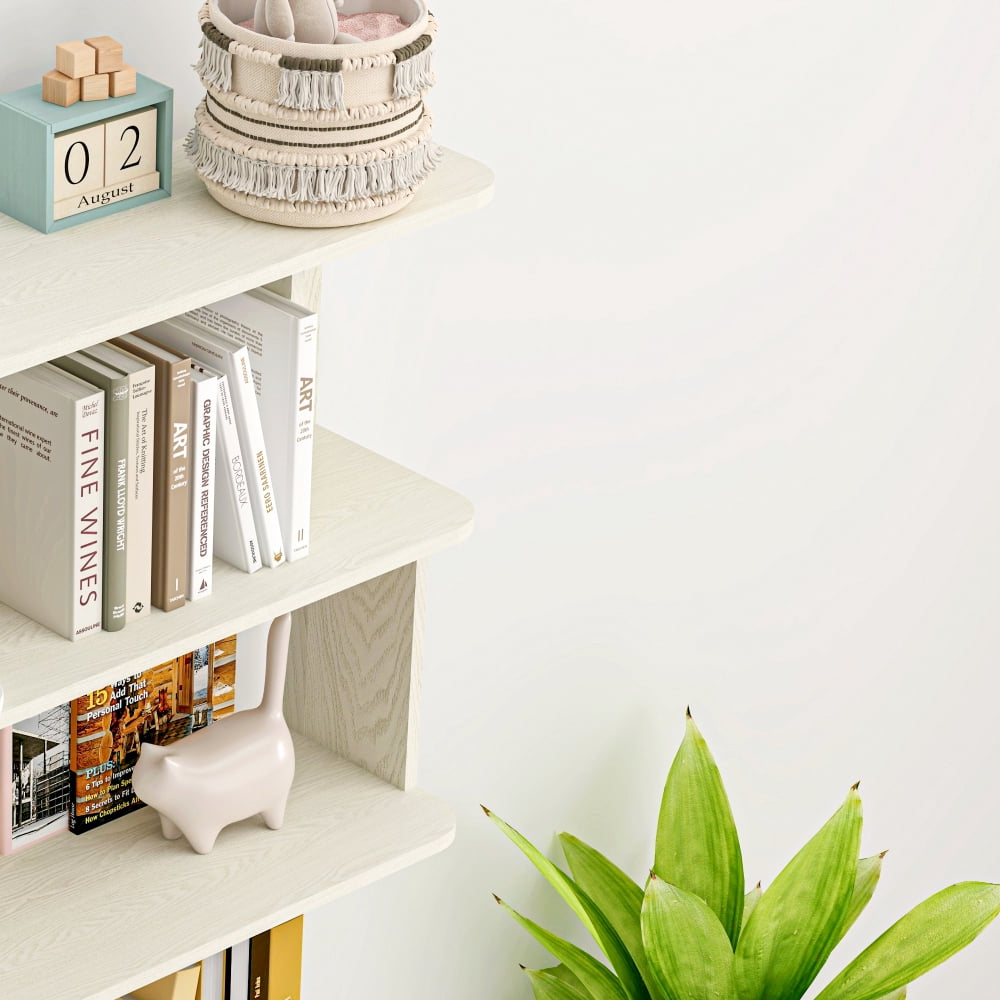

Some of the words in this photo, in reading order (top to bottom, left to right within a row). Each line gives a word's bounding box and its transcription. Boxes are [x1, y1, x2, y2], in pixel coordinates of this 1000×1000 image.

[77, 181, 134, 208] August
[298, 377, 314, 412] ART
[202, 399, 212, 446] GRAPHIC
[36, 434, 52, 446] expert
[173, 422, 188, 458] ART
[81, 429, 98, 498] FINE
[117, 458, 126, 488] FRANK
[201, 449, 210, 488] DESIGN
[256, 450, 270, 492] SAARINEN
[232, 456, 248, 508] BORDEAUX
[116, 488, 126, 516] LLOYD
[266, 493, 274, 513] EERO
[116, 518, 125, 551] WRIGHT
[200, 490, 209, 558] REFERENCED
[80, 507, 98, 606] WINES
[86, 690, 108, 710] 15
[110, 686, 126, 700] Add
[129, 678, 146, 693] That
[87, 700, 122, 722] Personal
[125, 690, 148, 706] Touch
[86, 760, 116, 780] PLUS:
[92, 779, 104, 788] Tips
[85, 793, 98, 802] How
[85, 815, 98, 824] How
[100, 802, 130, 818] Chopsticks
[92, 798, 112, 810] Secrets
